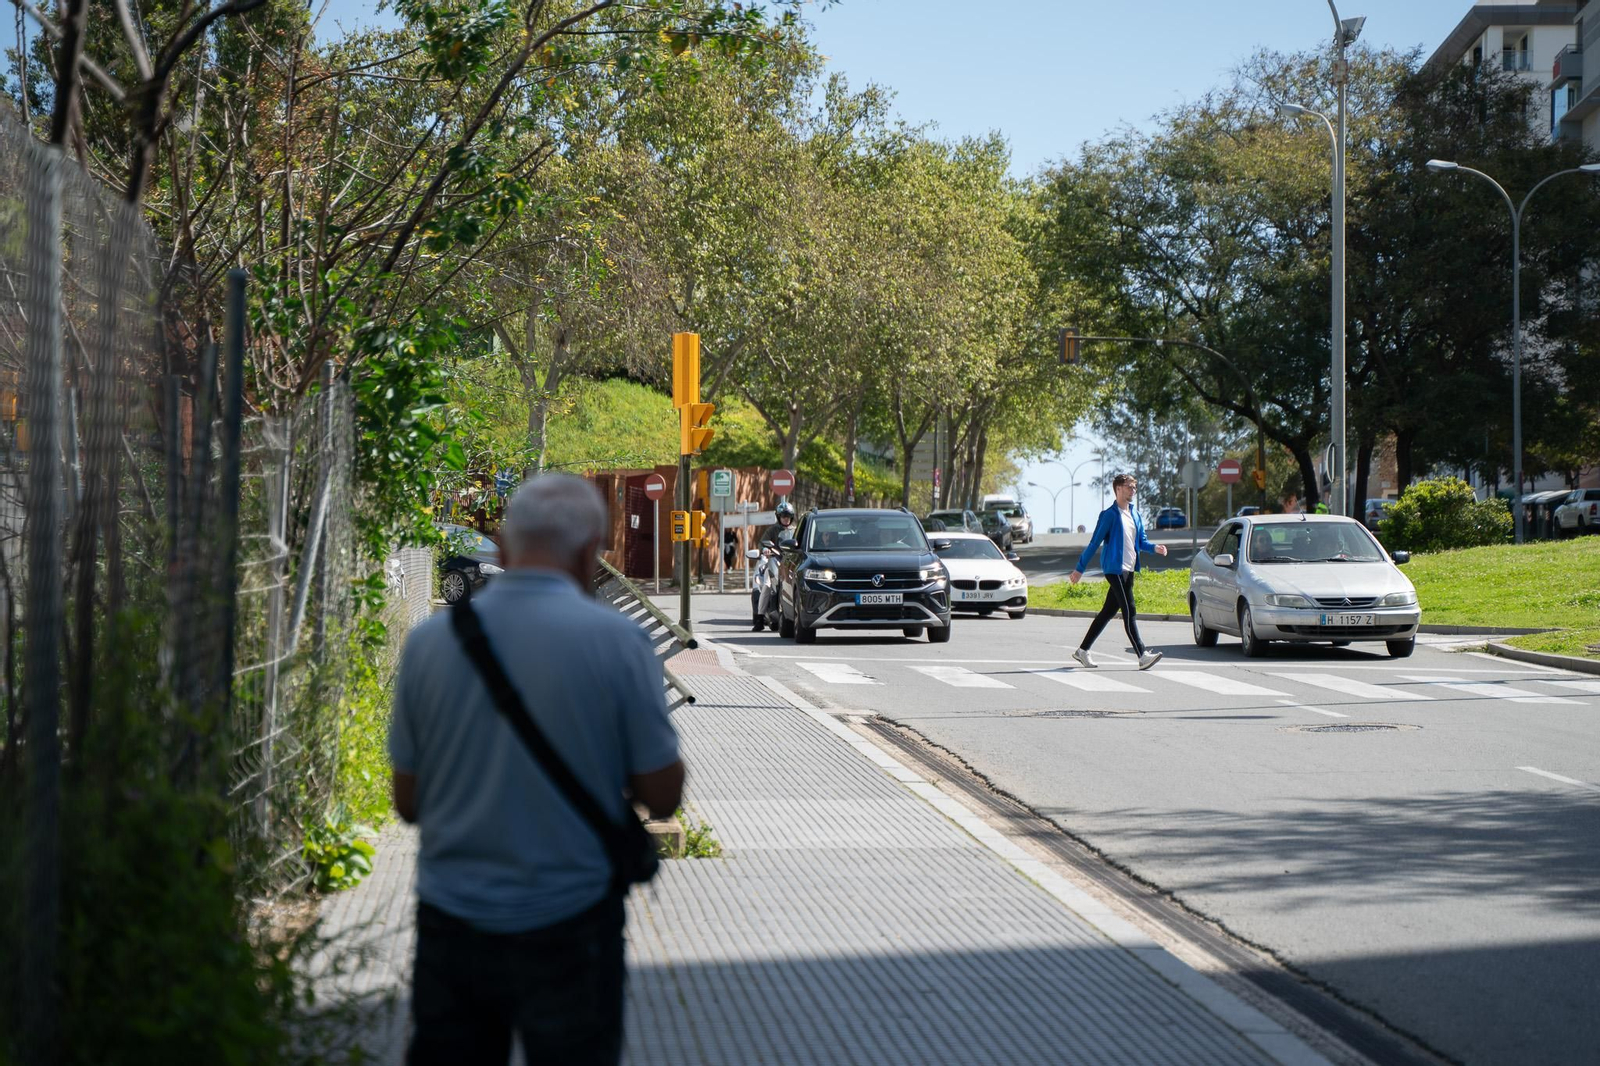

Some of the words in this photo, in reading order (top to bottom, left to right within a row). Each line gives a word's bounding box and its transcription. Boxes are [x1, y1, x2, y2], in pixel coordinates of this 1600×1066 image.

[862, 595, 883, 603] 8005
[885, 595, 901, 603] MTH
[1327, 616, 1334, 624] H
[1340, 616, 1362, 624] 1157
[1366, 616, 1372, 624] Z
